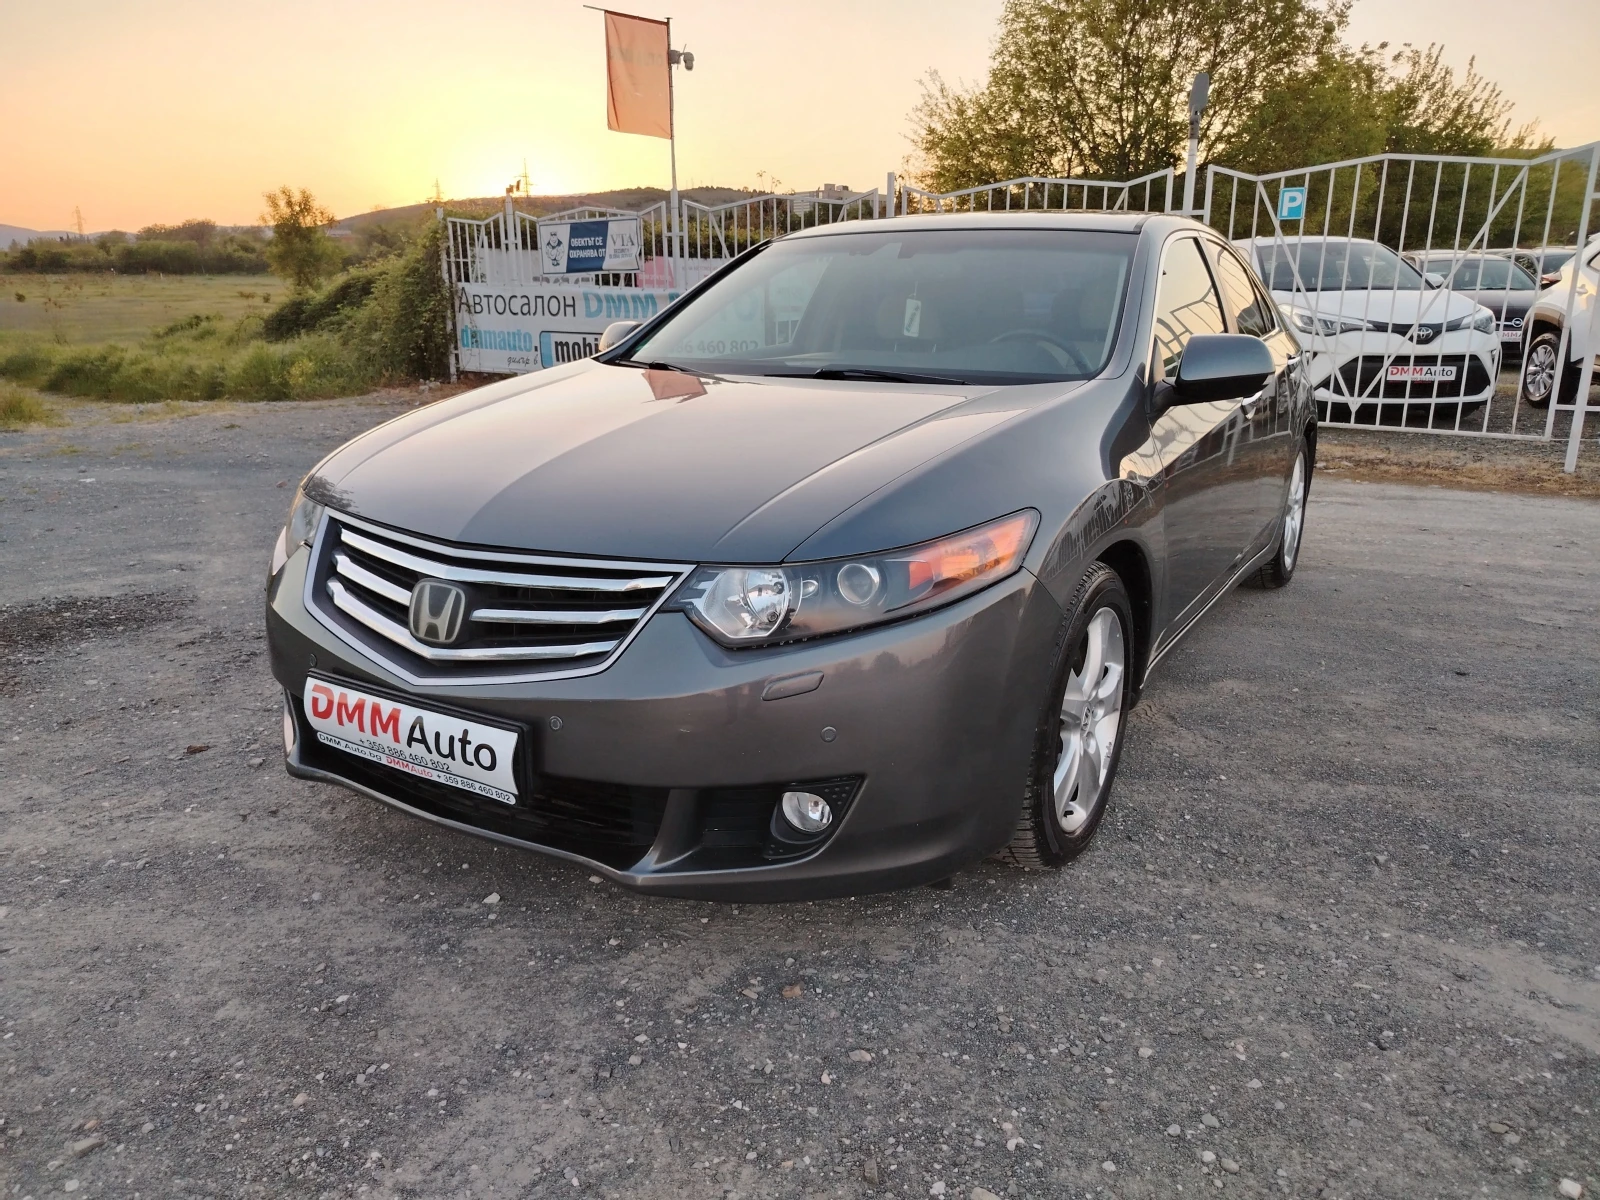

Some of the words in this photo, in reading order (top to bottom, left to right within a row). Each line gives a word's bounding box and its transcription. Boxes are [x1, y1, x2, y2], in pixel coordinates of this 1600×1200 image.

[1281, 191, 1303, 217] P
[570, 237, 595, 247] ОБЕКТЪТ
[595, 236, 604, 246] СЕ
[610, 233, 635, 247] VTA
[569, 249, 598, 259] ОХРАНЯВА
[598, 248, 606, 258] ОТ
[582, 291, 658, 319] DMM
[697, 340, 726, 354] 460
[366, 739, 386, 753] 359
[386, 746, 407, 760] 886
[408, 752, 428, 766] 460
[443, 774, 459, 785] 359
[460, 780, 477, 791] 886
[477, 785, 494, 797] 460
[495, 790, 512, 803] 802
